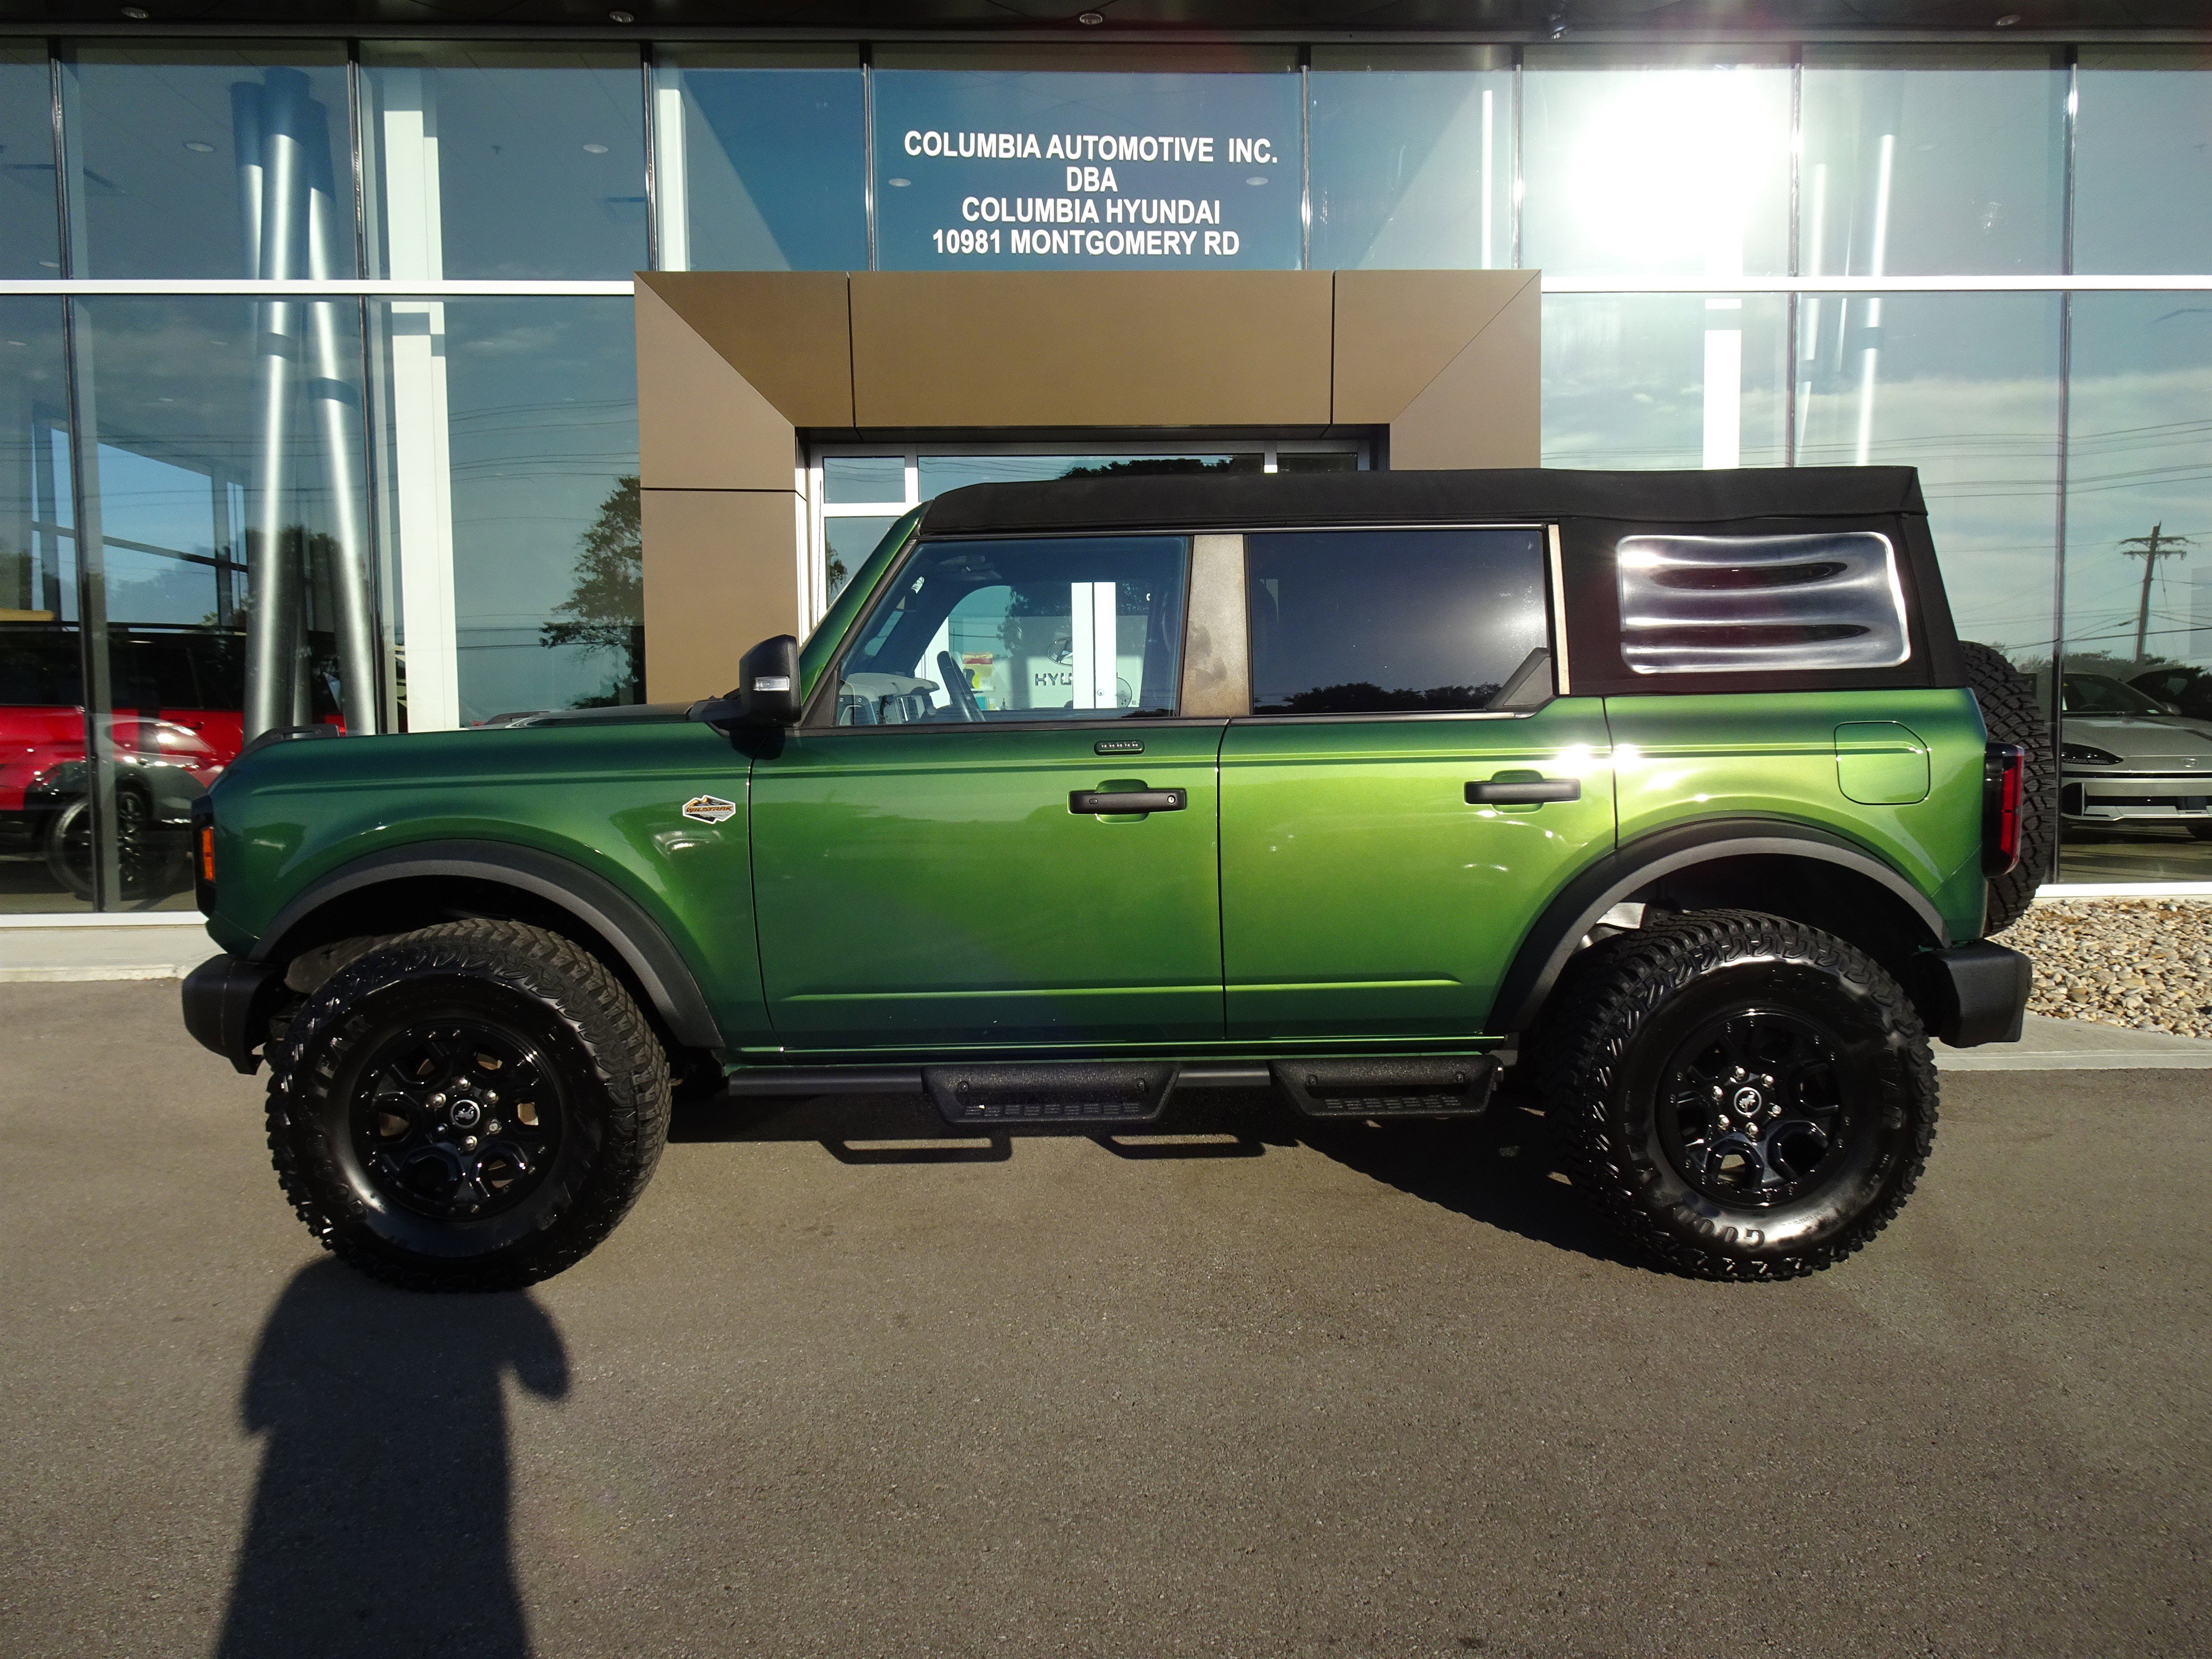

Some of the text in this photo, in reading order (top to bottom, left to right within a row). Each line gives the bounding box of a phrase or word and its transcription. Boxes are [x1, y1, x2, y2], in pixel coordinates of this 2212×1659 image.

[904, 130, 1278, 164] COLUMBIA AUTOMOTIVE INC.
[1066, 166, 1118, 193] DBA
[962, 196, 1220, 225] COLUMBIA HYUNDAI
[932, 228, 1240, 256] 10981 MONTGOMERY RD
